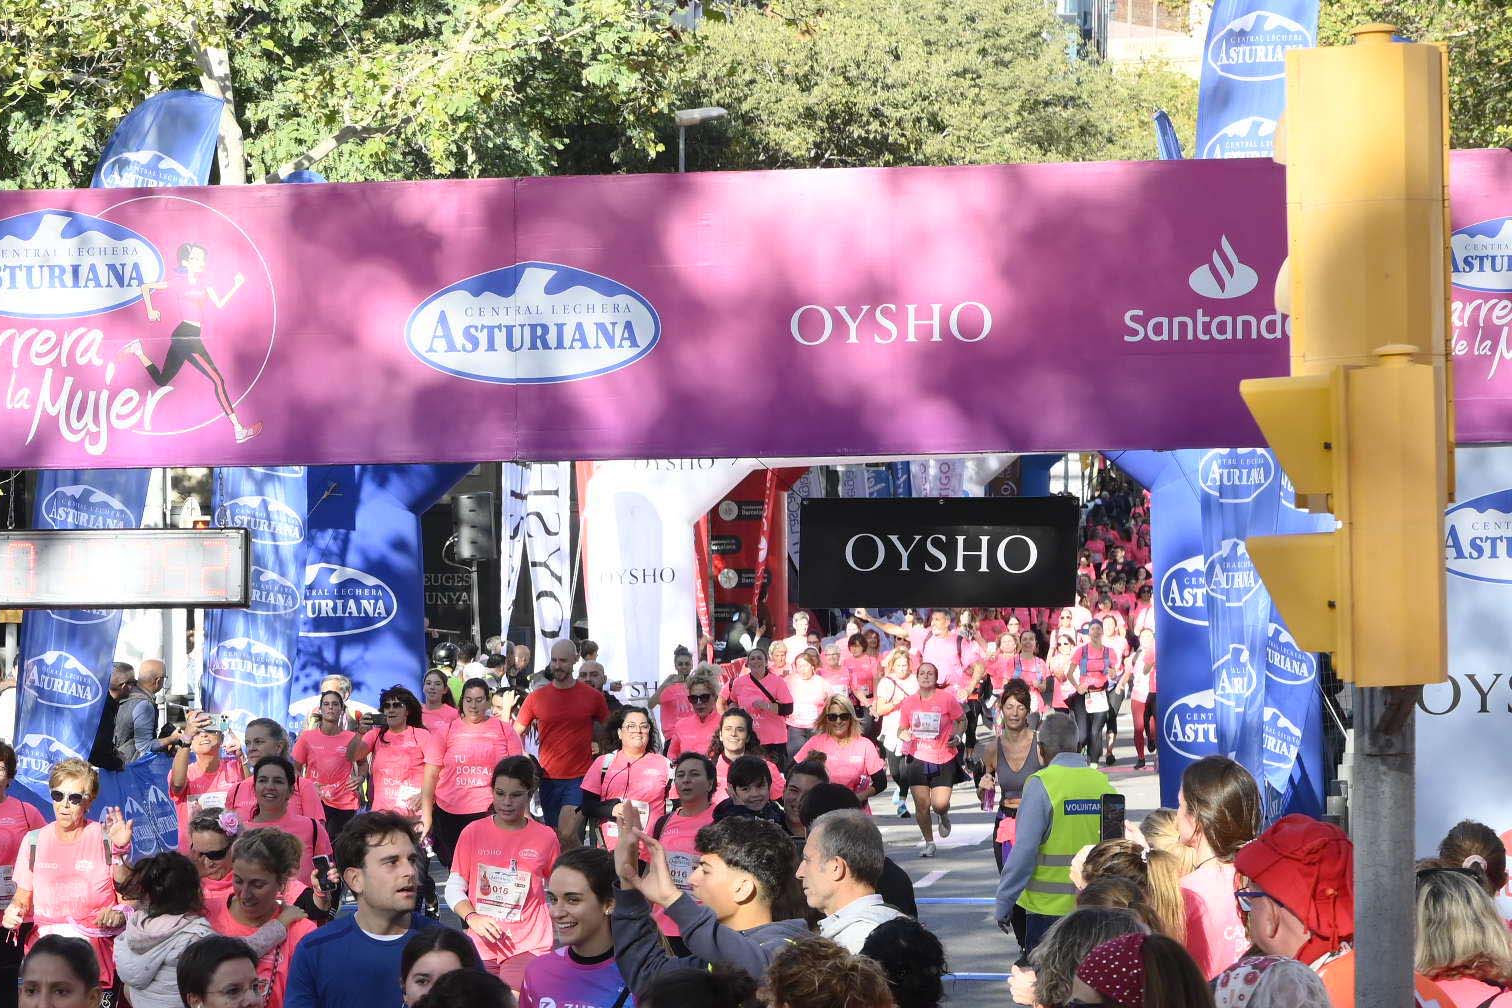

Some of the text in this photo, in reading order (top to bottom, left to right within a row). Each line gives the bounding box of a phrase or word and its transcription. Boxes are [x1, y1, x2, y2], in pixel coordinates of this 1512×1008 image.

[1217, 39, 1304, 66] ASTURIA
[68, 246, 140, 258] LECHERA
[464, 303, 632, 318] CENTRAL LECHERA
[791, 300, 993, 346] OYSHO
[425, 310, 641, 354] ASTURIANA
[6, 369, 31, 410] la
[25, 364, 175, 455] Mujer
[845, 533, 1038, 575] OYSHO
[601, 567, 677, 585] OYSHO
[333, 587, 383, 597] LECHERA
[455, 776, 484, 786] SUMA
